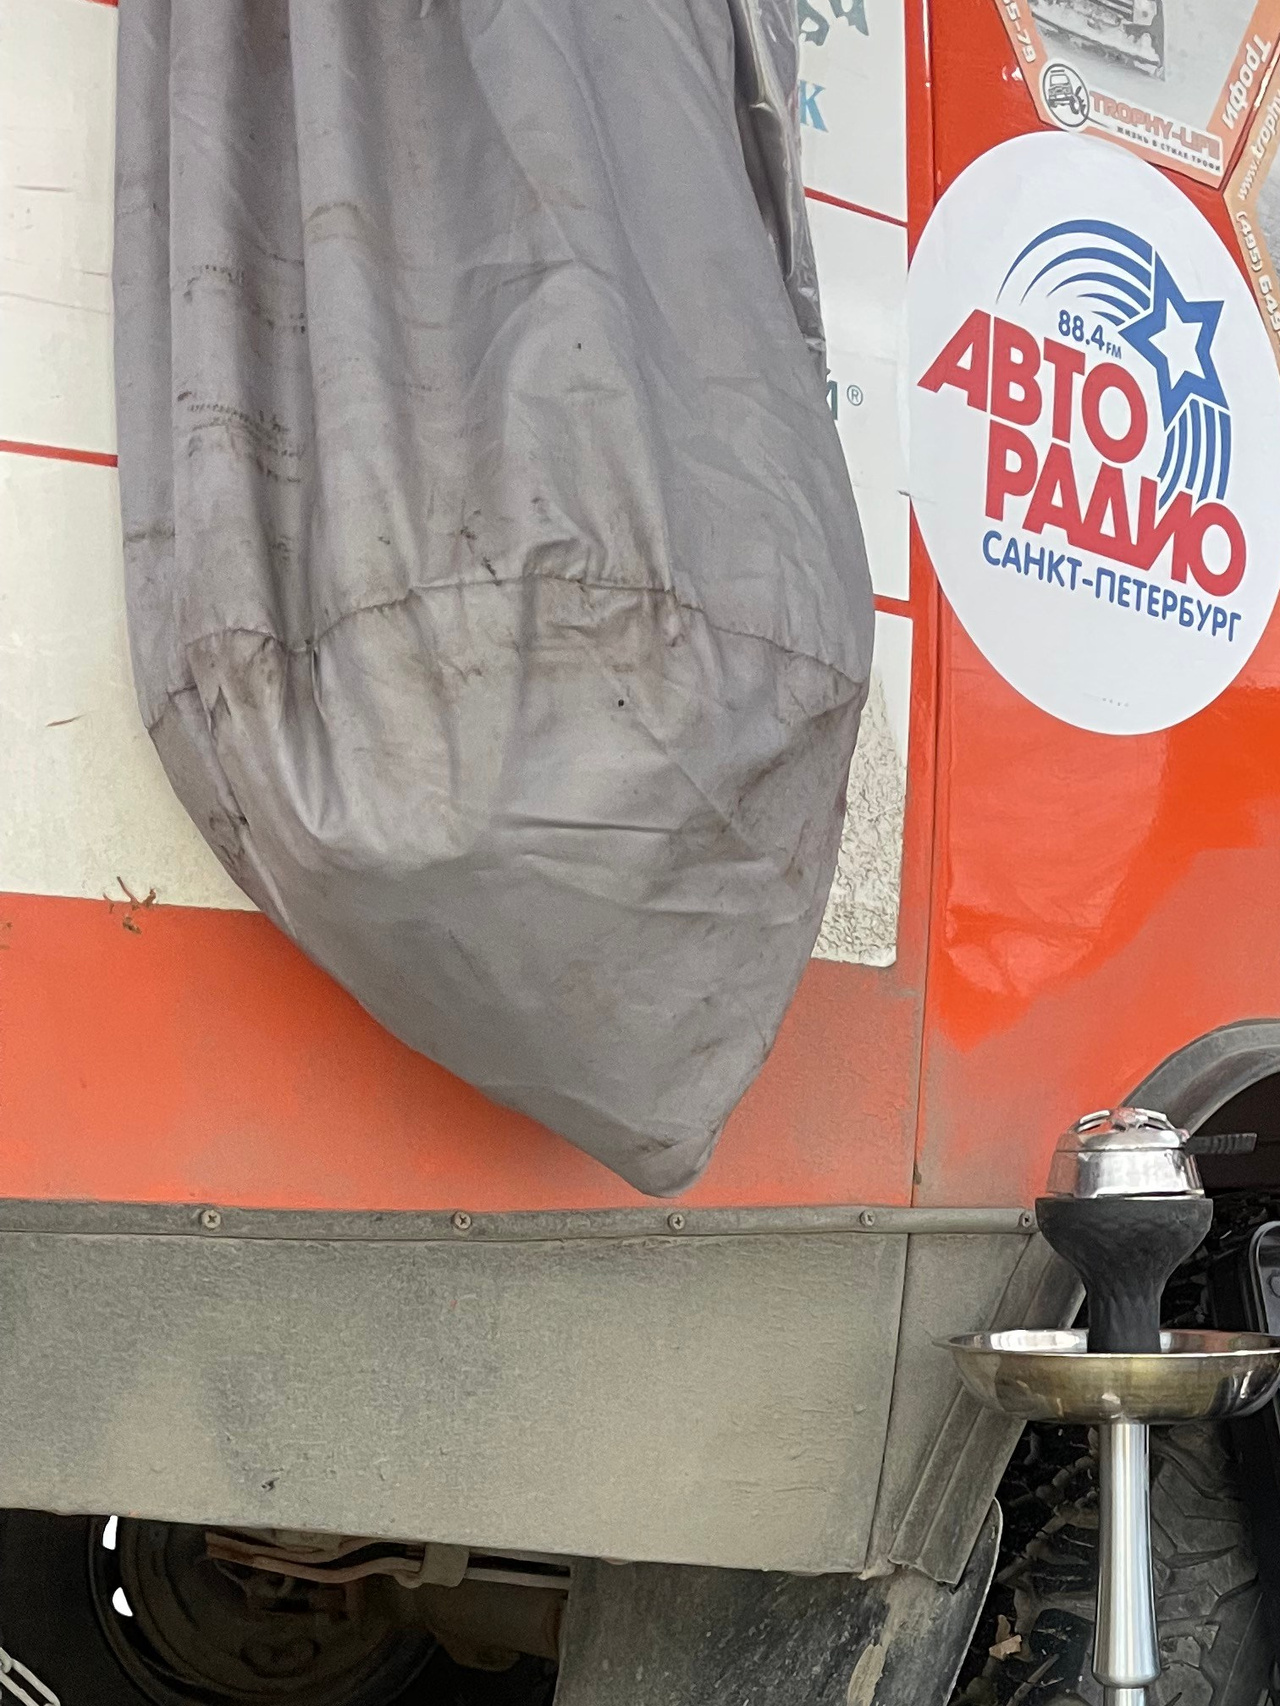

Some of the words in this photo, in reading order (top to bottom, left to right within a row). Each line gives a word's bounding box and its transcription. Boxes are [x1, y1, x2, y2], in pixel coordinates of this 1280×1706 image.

[1221, 34, 1272, 130] Трофи
[1236, 211, 1263, 272] (495)
[917, 309, 1148, 464] АВТО
[1058, 310, 1105, 351] 88.4
[1106, 342, 1123, 359] FM
[985, 419, 1246, 597] РАДИО
[982, 530, 1243, 642] САНКТ-ПЕТЕРБУРГ
